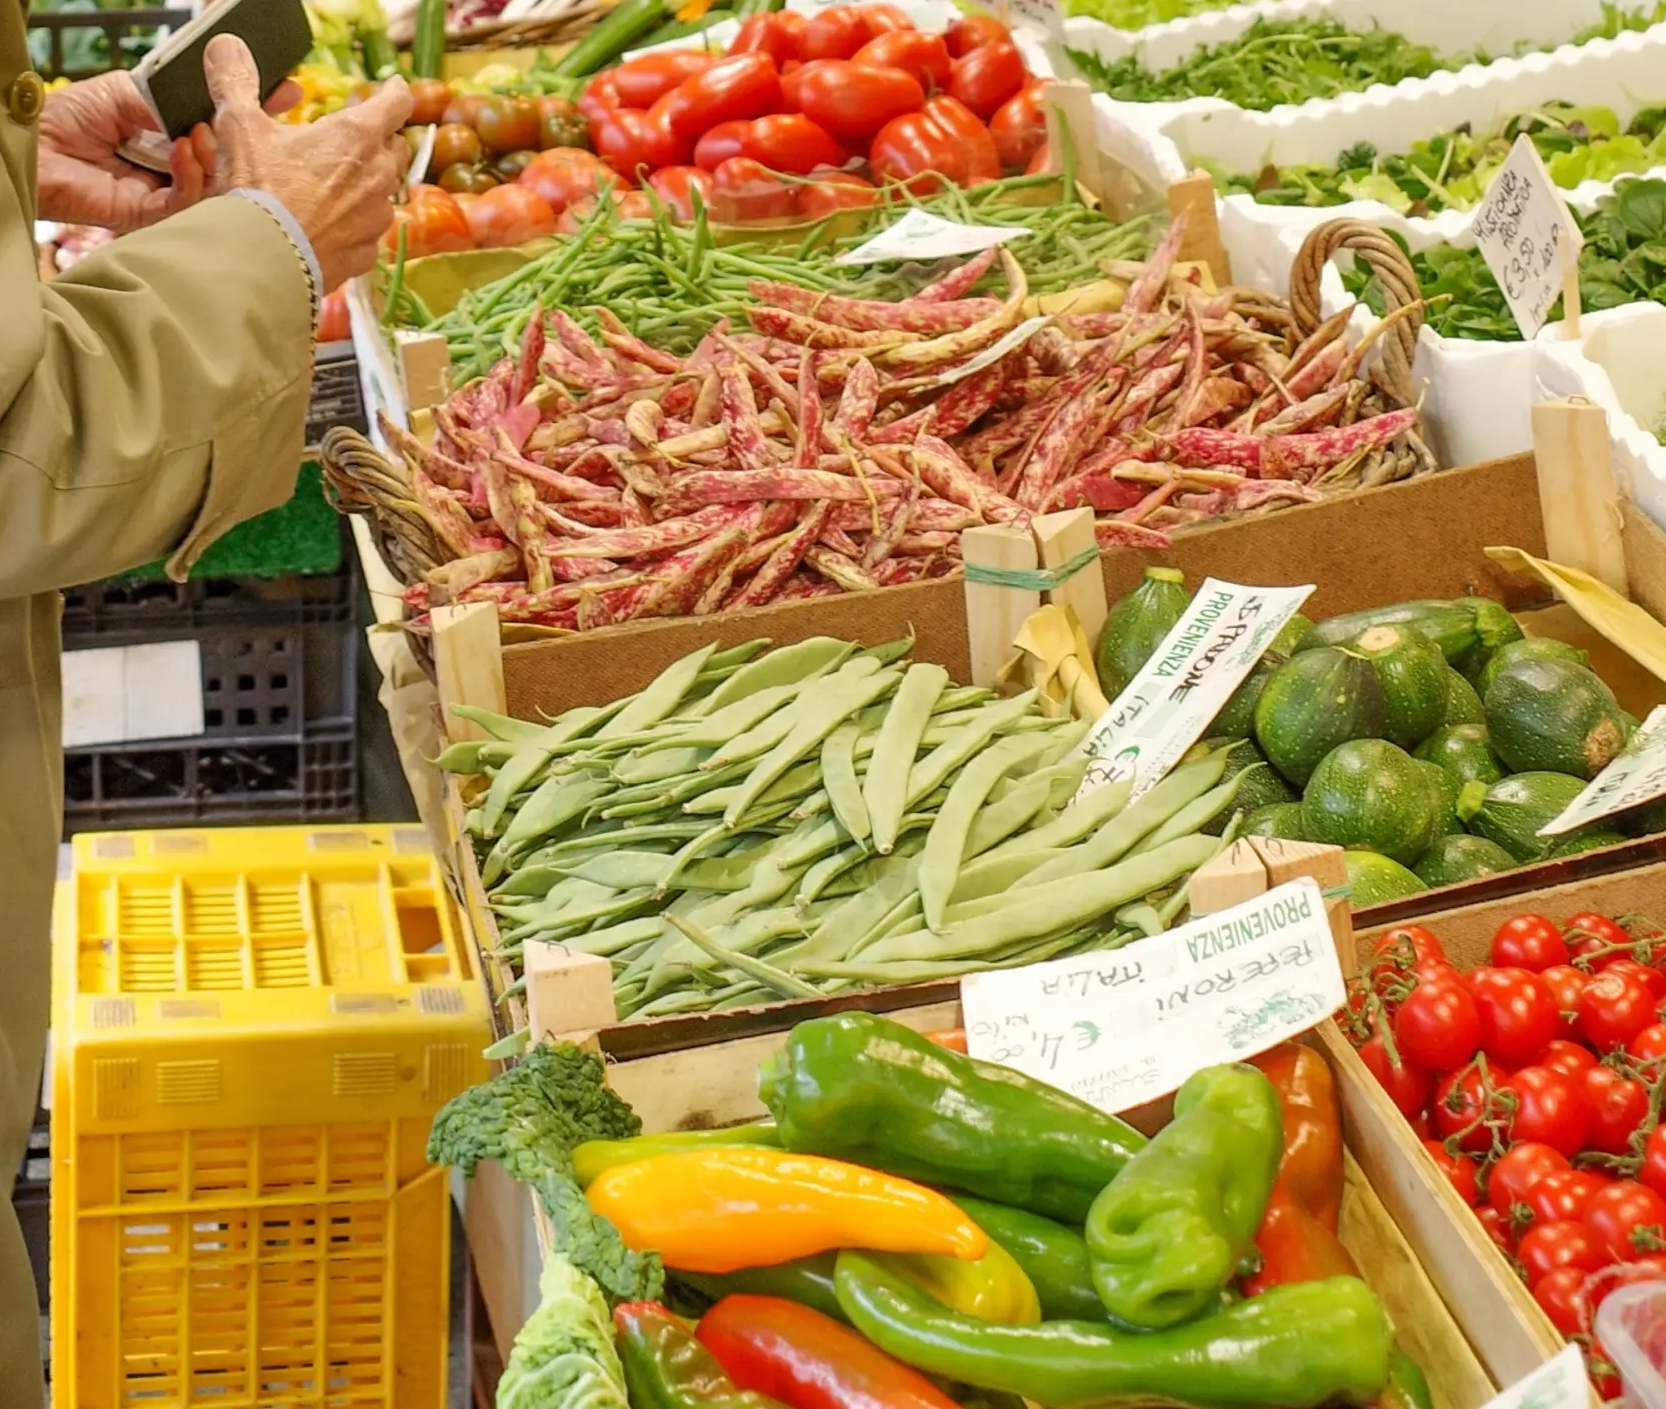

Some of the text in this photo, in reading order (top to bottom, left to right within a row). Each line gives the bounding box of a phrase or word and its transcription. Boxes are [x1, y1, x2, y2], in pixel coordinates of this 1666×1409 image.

[1153, 591, 1234, 679] PROVENIENZA
[1186, 891, 1312, 963] PROVENIENZA
[1071, 1019, 1102, 1051] €
